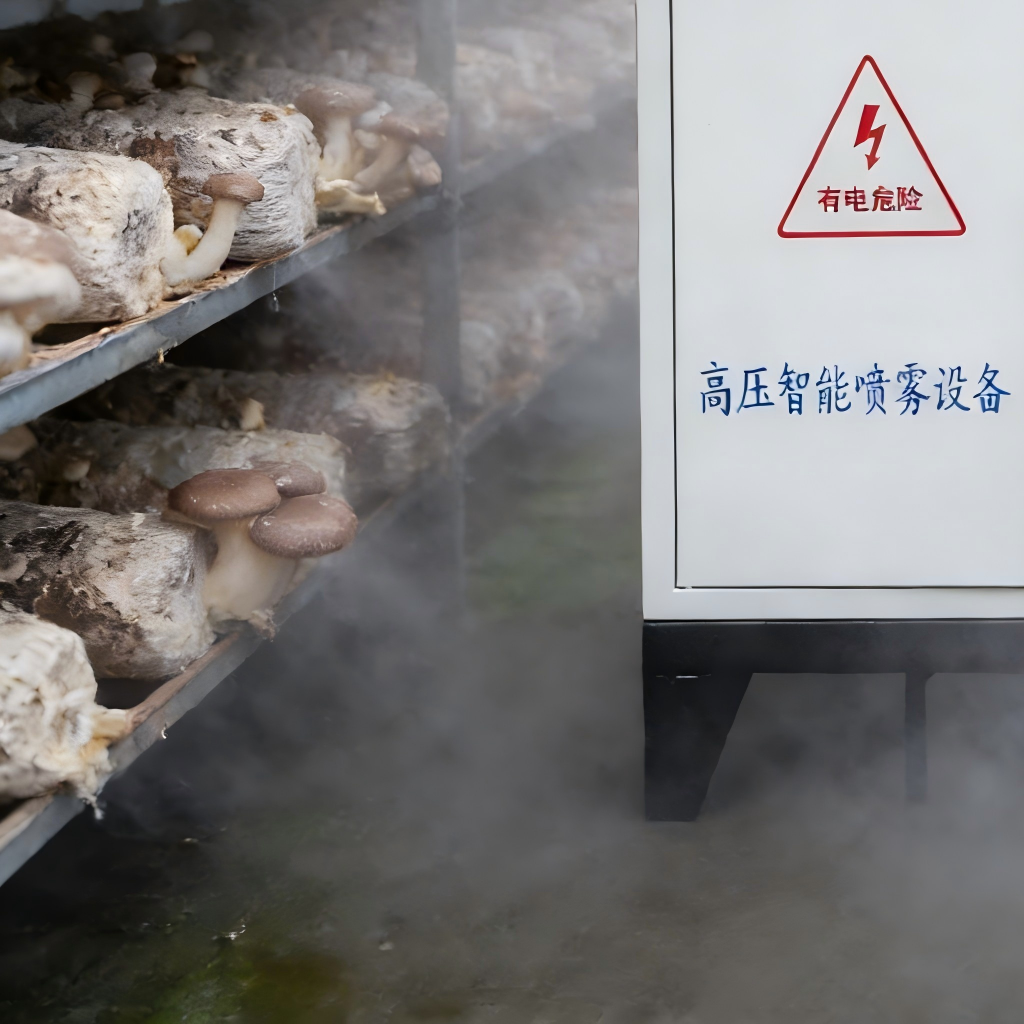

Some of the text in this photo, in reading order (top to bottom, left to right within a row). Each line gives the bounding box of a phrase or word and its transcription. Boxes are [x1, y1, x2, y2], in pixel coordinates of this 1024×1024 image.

[817, 185, 924, 213] 有电危险
[700, 361, 1012, 417] 高压智能喷雾设备
